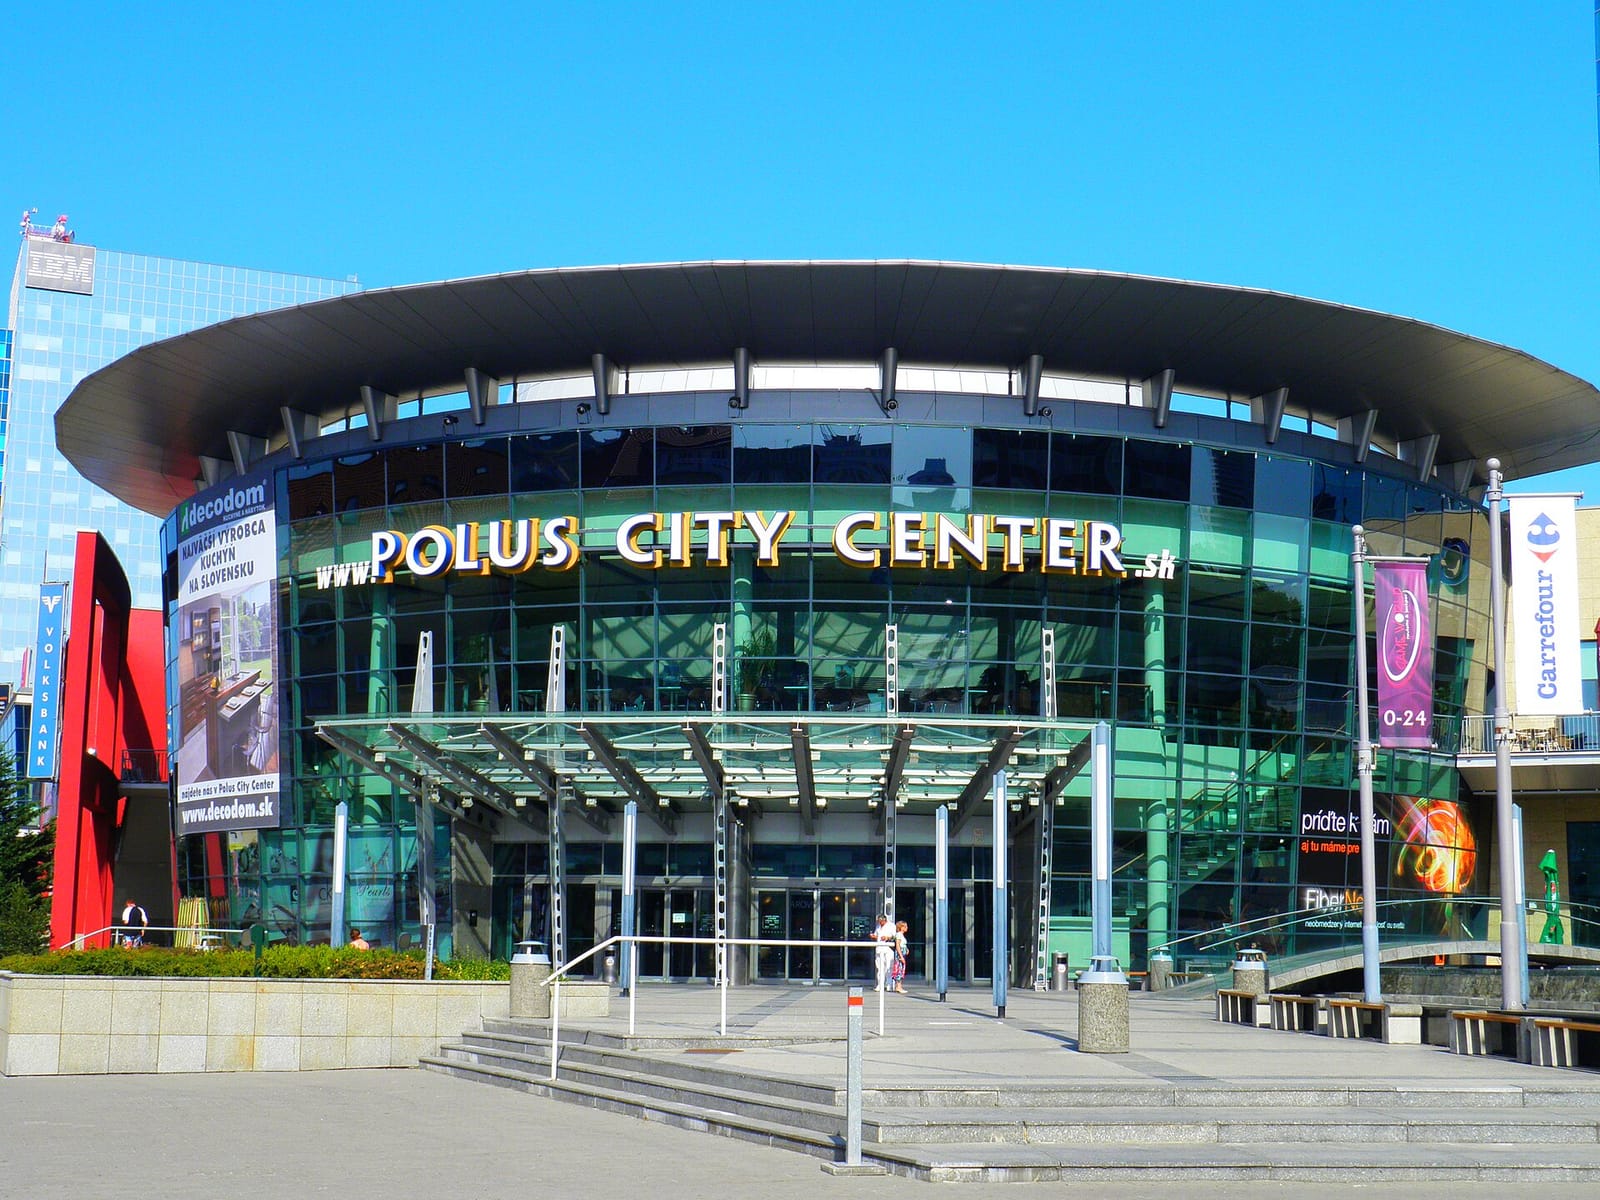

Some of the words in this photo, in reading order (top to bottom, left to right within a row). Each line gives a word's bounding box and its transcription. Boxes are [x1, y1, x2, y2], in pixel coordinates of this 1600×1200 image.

[28, 250, 93, 283] IBM
[189, 484, 265, 528] decodom
[316, 561, 376, 590] www.
[372, 517, 579, 582] POLUS
[616, 511, 795, 568] CITY
[832, 512, 1127, 578] CENTER
[1134, 548, 1176, 580] .sk
[188, 577, 199, 594] NA
[201, 560, 254, 589] SLOVENSKU
[1534, 569, 1557, 700] Carrefour
[36, 626, 55, 767] VOLKSBANK
[1383, 709, 1427, 726] 0-24
[219, 782, 235, 794] Polus
[236, 780, 250, 793] City
[251, 779, 274, 790] Center
[182, 795, 274, 824] www.decodom.sk
[1301, 840, 1309, 853] aj
[1310, 840, 1319, 852] tu
[1346, 844, 1360, 855] pre
